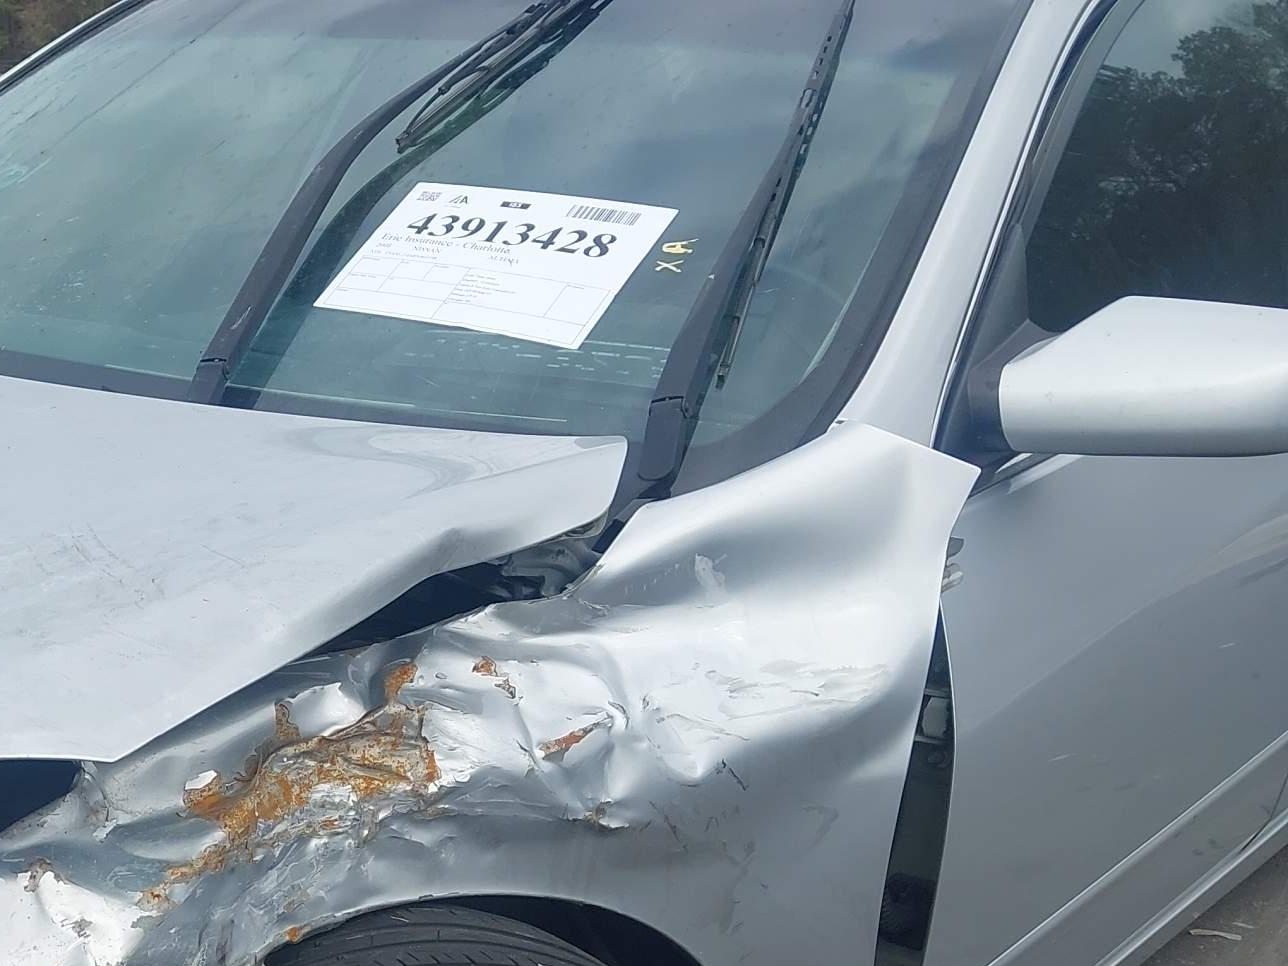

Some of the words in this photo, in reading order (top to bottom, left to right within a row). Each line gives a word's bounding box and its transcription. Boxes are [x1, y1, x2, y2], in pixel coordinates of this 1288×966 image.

[404, 235, 454, 248] Insurance
[462, 241, 512, 255] Charlotte
[406, 212, 617, 259] 43913428
